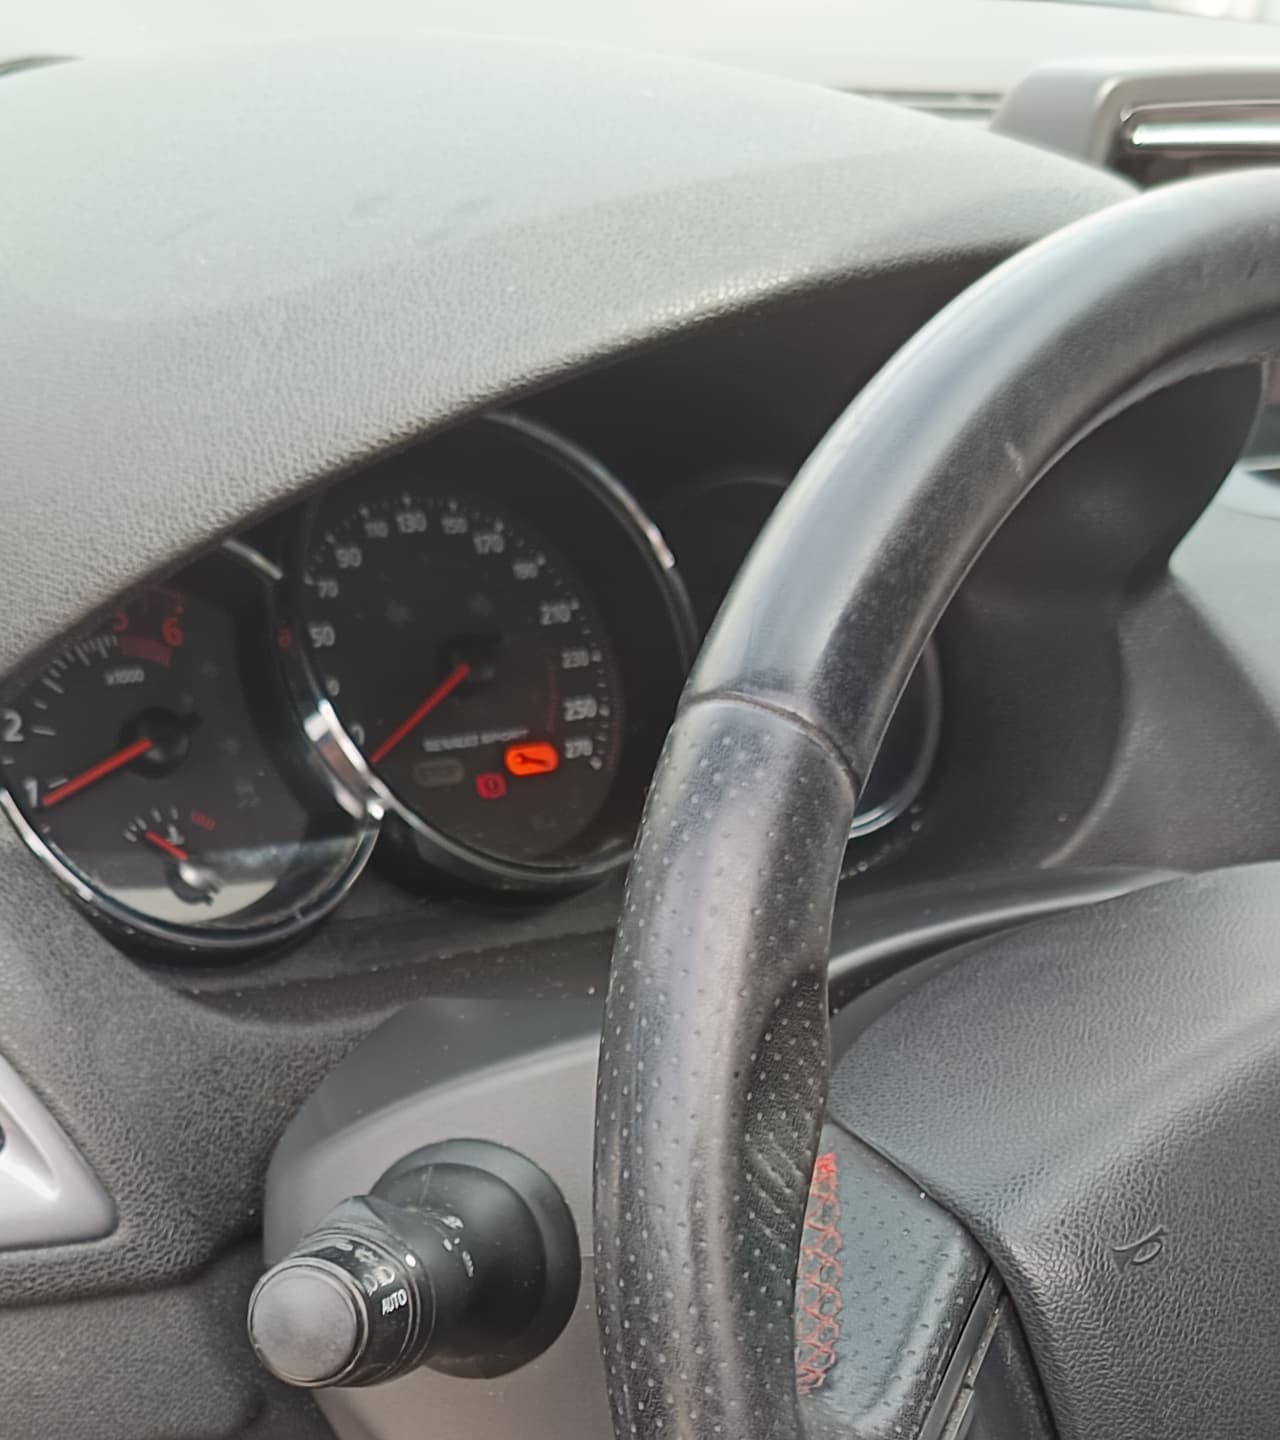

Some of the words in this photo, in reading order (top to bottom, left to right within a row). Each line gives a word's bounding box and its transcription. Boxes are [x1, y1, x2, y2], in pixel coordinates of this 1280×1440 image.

[396, 512, 427, 534] 130
[442, 516, 468, 535] 150
[473, 533, 504, 554] 170
[335, 546, 363, 568] 90
[318, 580, 340, 599] 70
[540, 603, 572, 625] 210
[163, 616, 185, 647] 6
[310, 625, 336, 649] 50
[562, 648, 590, 669] 230
[563, 697, 598, 721] 250
[4, 711, 24, 743] 2
[565, 738, 594, 760] 270
[25, 778, 39, 807] 1
[382, 1288, 408, 1316] AUTO
